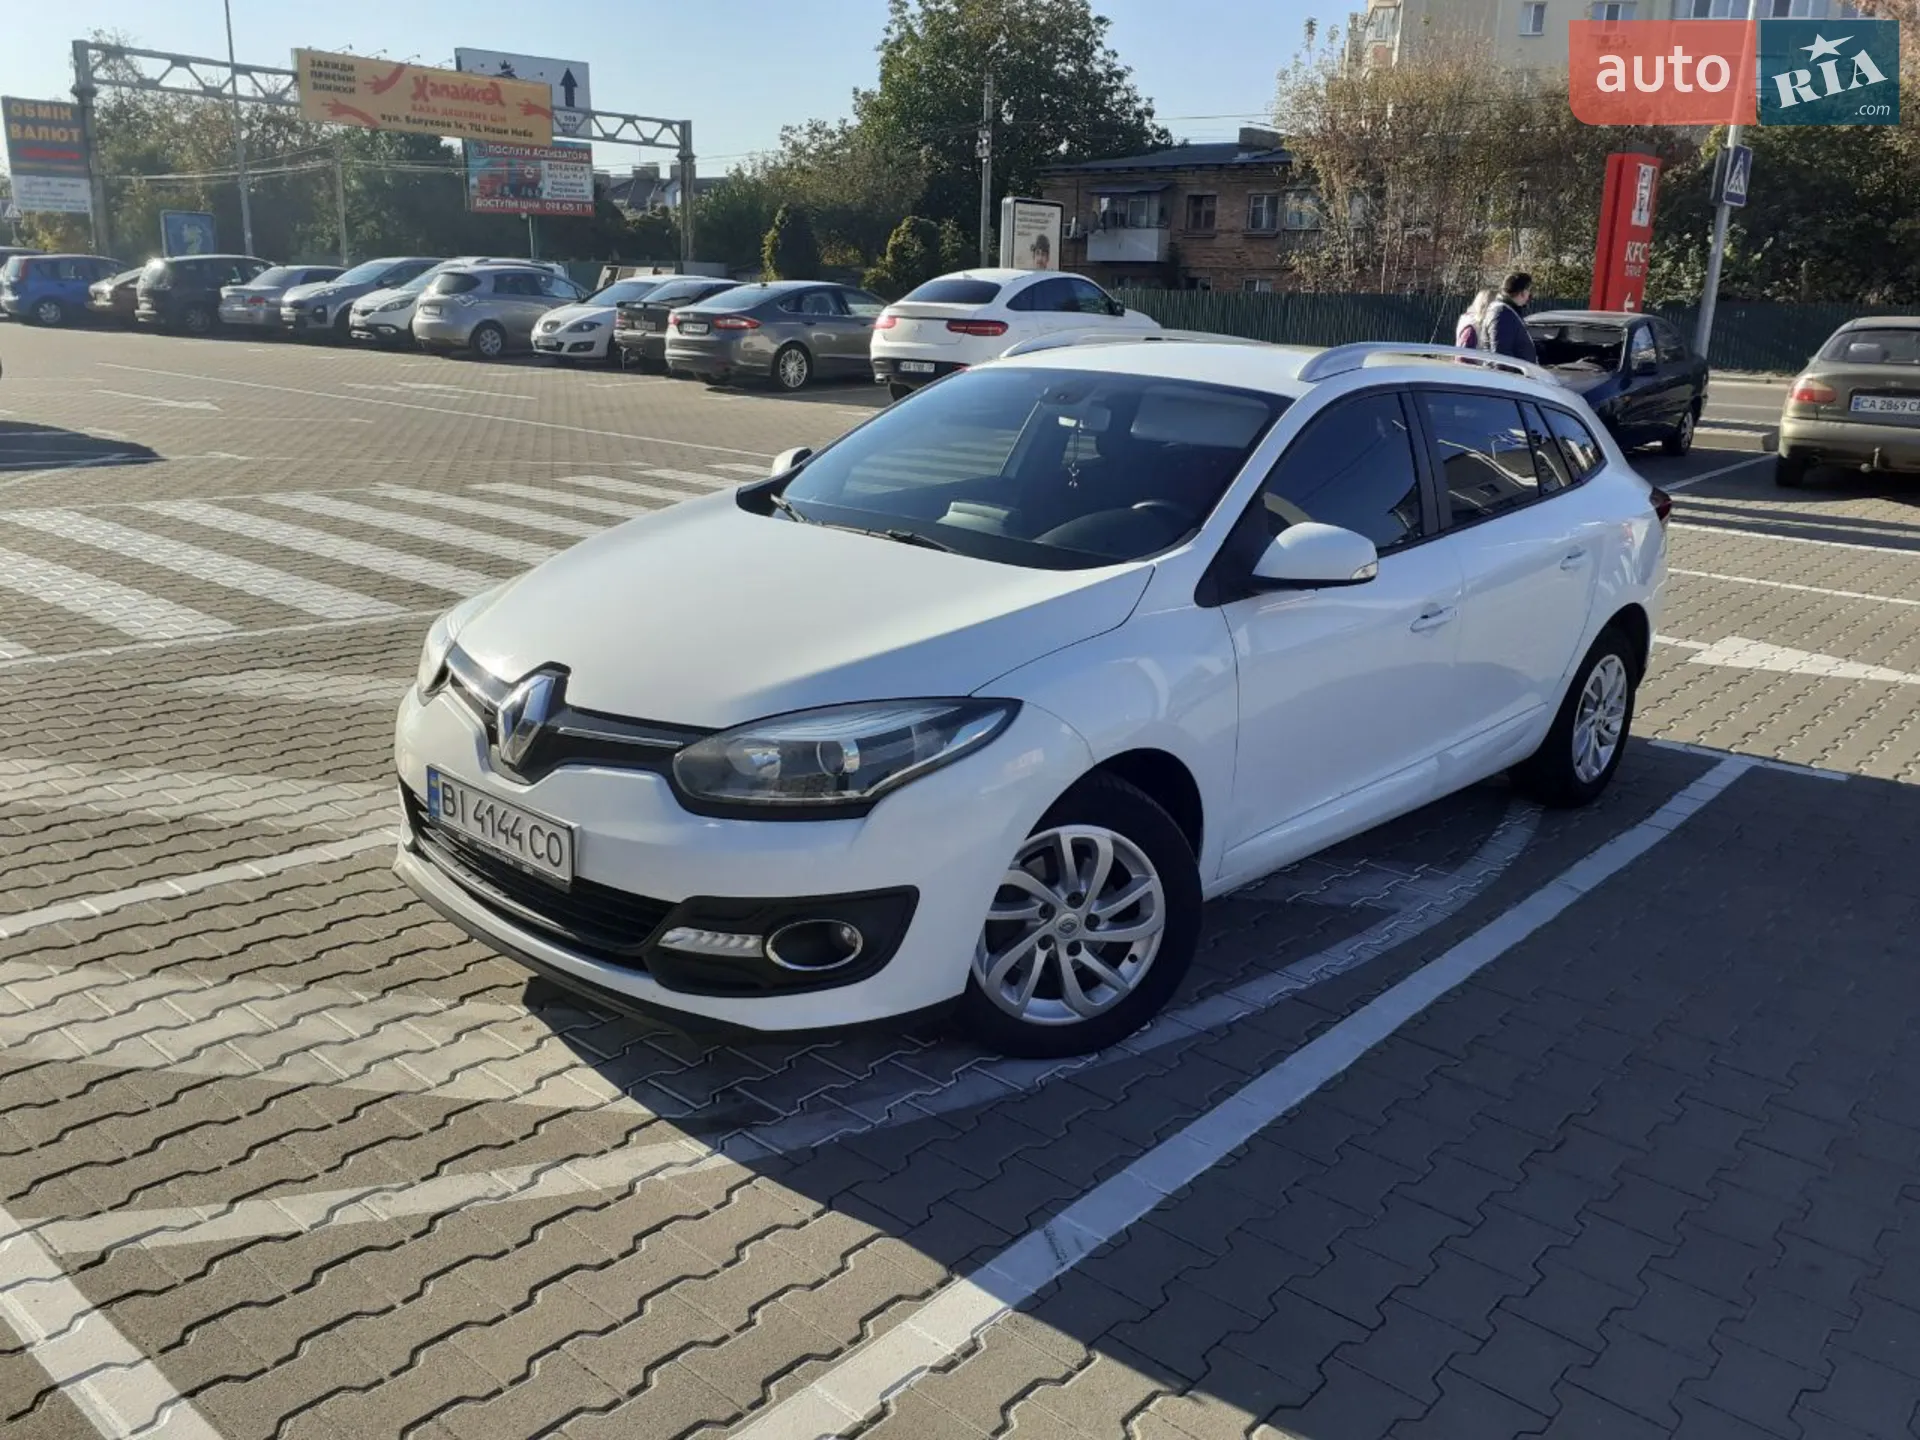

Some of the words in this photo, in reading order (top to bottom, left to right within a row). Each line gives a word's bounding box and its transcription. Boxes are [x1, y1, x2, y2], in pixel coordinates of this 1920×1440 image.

[310, 59, 355, 72] ЗАВЖДИ
[312, 81, 356, 94] ЗНИЖКИ
[11, 103, 72, 121] ОБМІН
[10, 122, 80, 143] ВАЛЮТ
[484, 125, 509, 135] Наше
[488, 145, 530, 156] ПОСЛУГИ
[1624, 241, 1648, 262] KFC
[1861, 399, 1876, 409] CA
[1880, 400, 1907, 411] 2869
[442, 781, 465, 824] BI
[473, 799, 523, 852] 4144
[529, 824, 563, 868] CO
